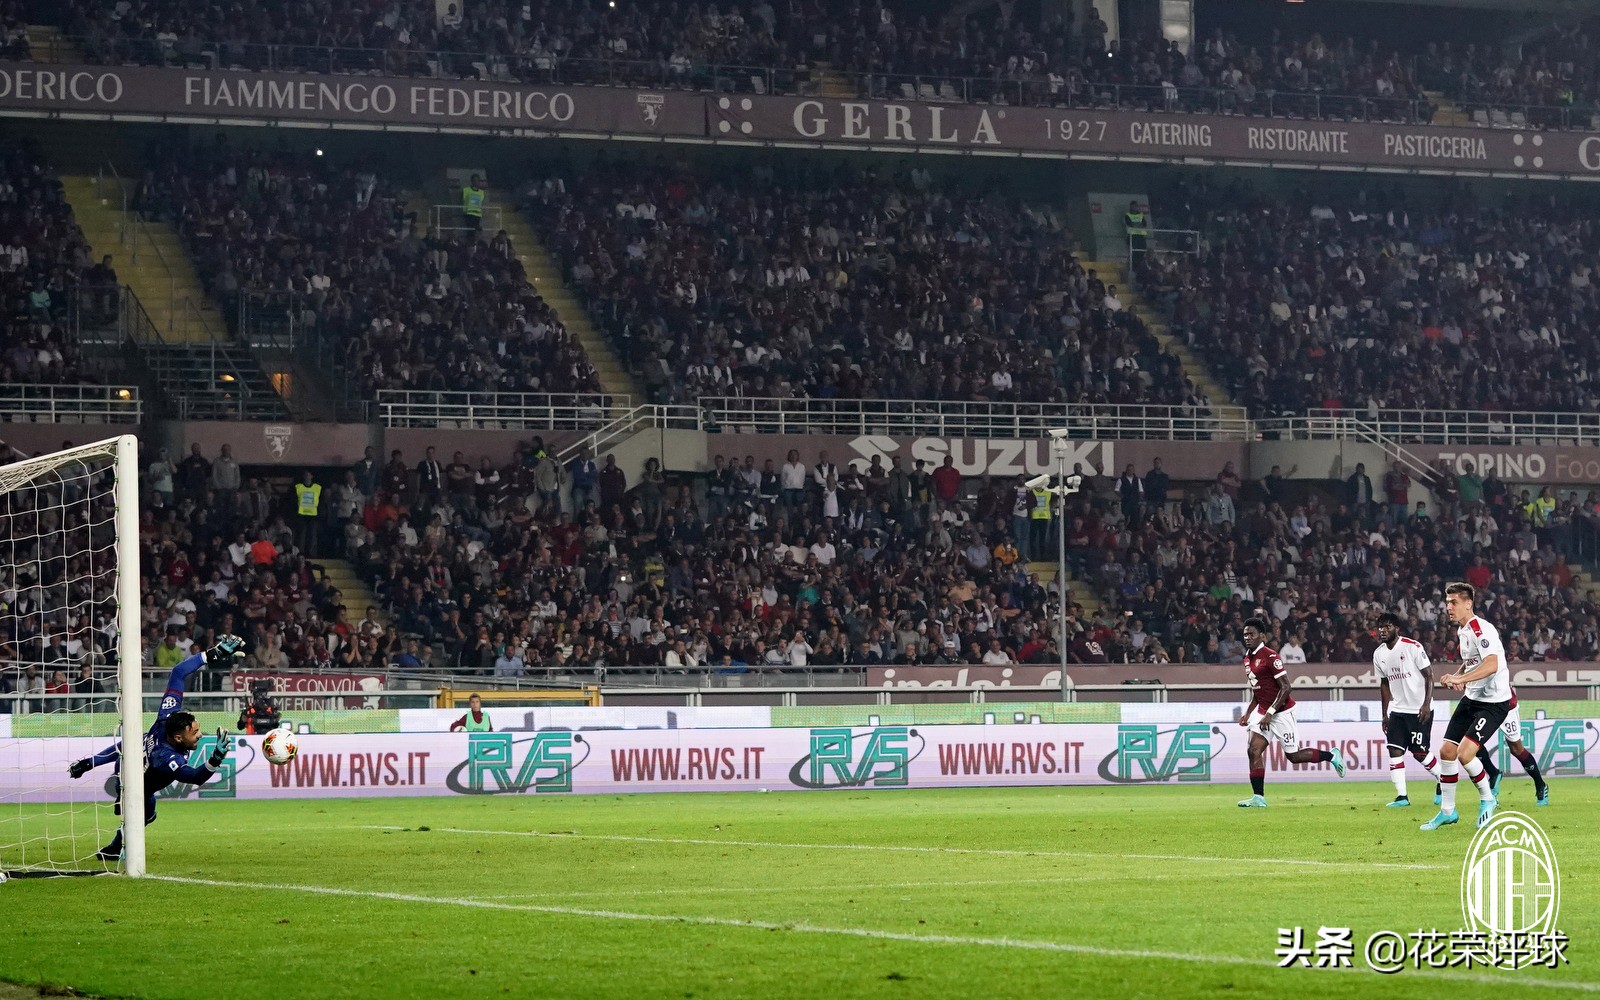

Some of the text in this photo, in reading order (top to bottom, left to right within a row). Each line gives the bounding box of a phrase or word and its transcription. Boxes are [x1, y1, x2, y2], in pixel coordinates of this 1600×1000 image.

[185, 77, 575, 121] FIAMMENGO FEDERICO
[793, 100, 1487, 160] GERLA 1927 CATERING RISTORANTE PASTICCERIA
[911, 436, 1114, 477] SUZUKI
[1283, 733, 1295, 743] 34
[1411, 732, 1423, 745] 79
[1475, 717, 1487, 731] 9
[1504, 721, 1517, 734] 36
[269, 752, 430, 788] WWW.RVS.IT
[468, 733, 573, 793] RVS
[611, 747, 765, 782] WWW.RVS.IT
[810, 727, 908, 786] RVS
[938, 741, 1085, 775] WWW.RVS.IT
[1117, 724, 1211, 782] RVS
